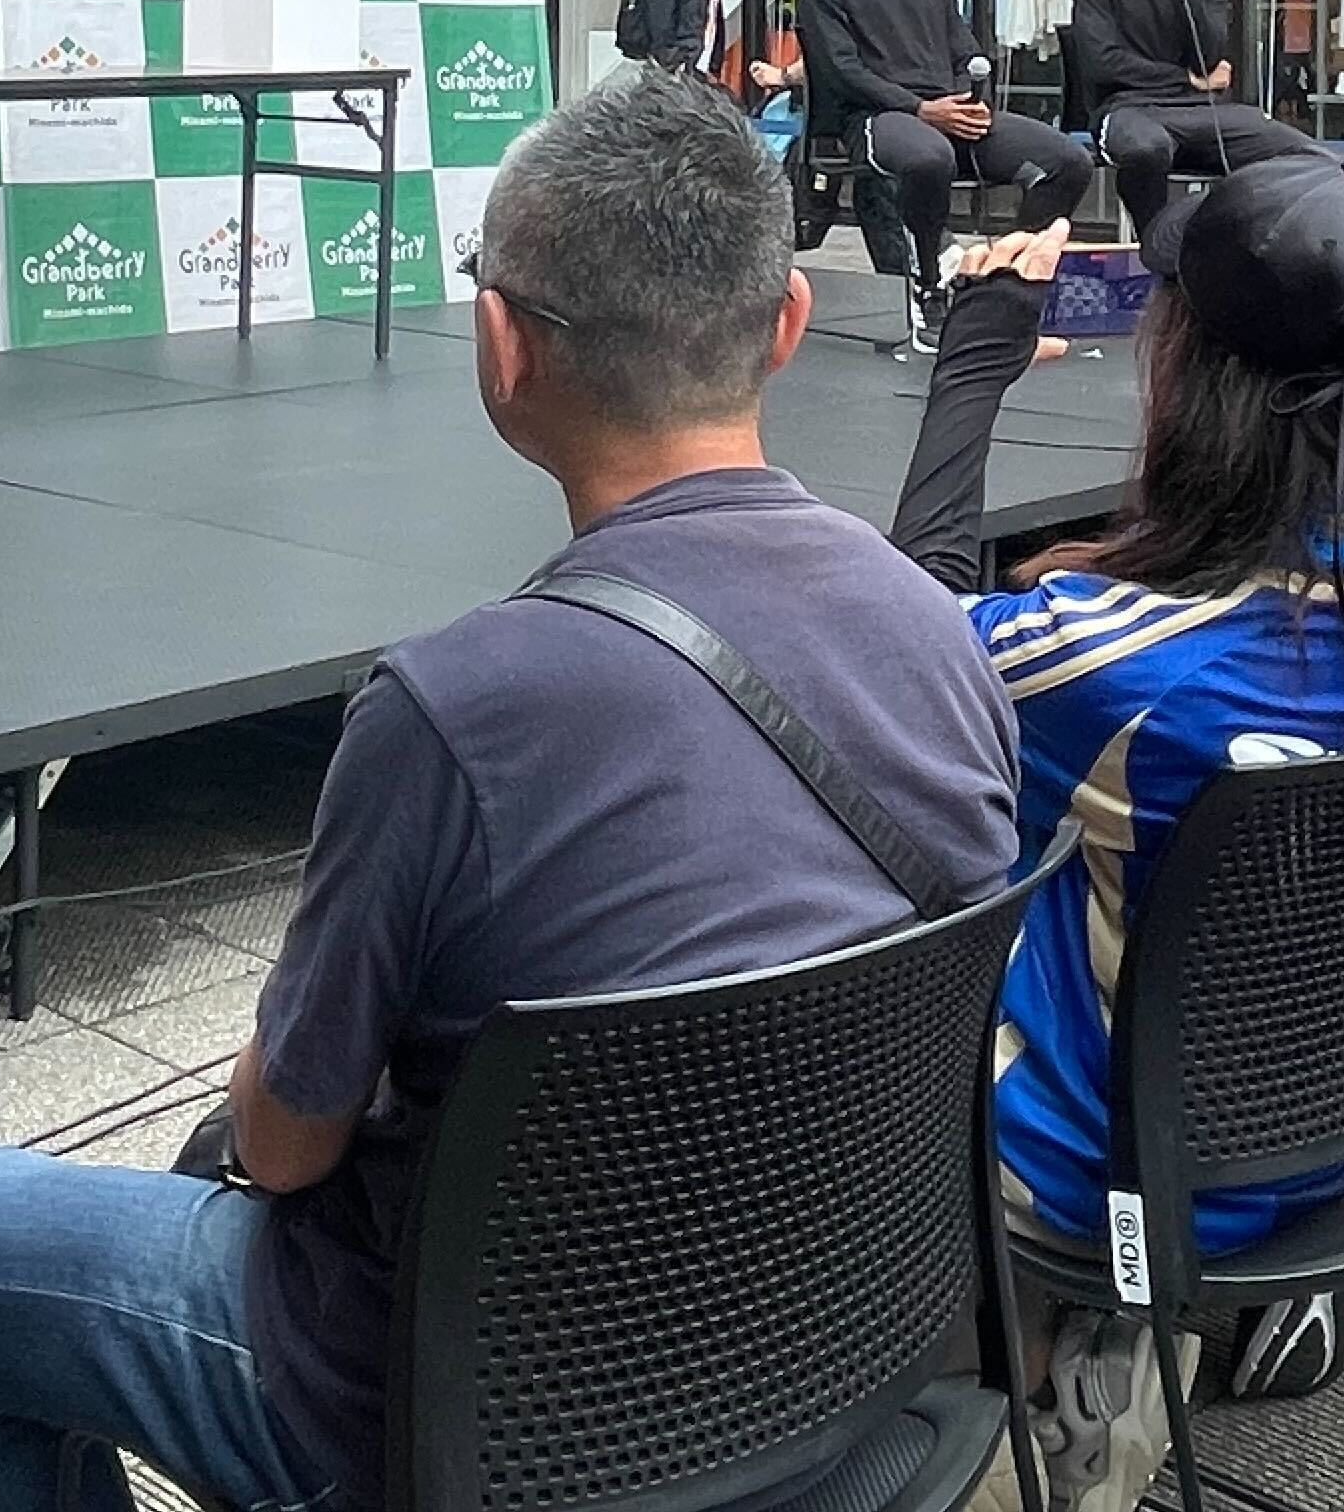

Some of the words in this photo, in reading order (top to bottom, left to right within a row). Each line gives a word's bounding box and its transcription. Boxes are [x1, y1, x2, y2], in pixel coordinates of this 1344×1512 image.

[436, 61, 536, 91] Grandberry
[469, 91, 501, 109] Park
[178, 240, 291, 274] Granderry
[322, 232, 425, 265] Granderry
[22, 248, 146, 285] Grandberry
[66, 283, 106, 302] Park
